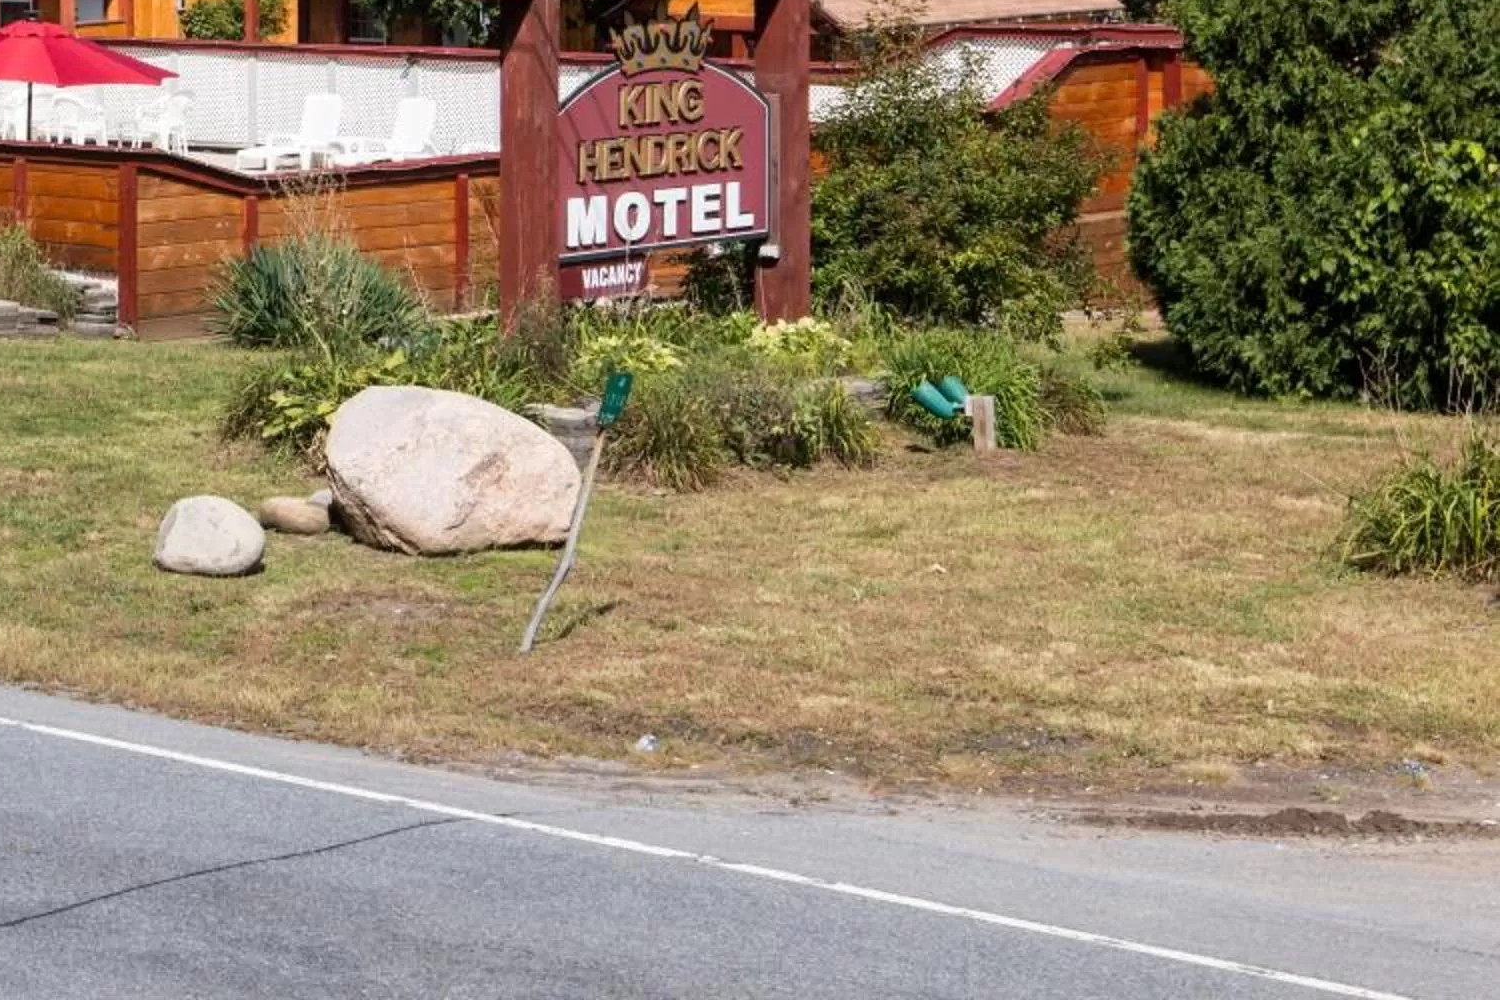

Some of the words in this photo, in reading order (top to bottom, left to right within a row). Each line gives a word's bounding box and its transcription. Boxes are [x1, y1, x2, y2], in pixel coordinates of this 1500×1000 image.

[619, 79, 705, 129] KING
[577, 126, 744, 185] HENDRICK
[565, 181, 754, 249] MOTEL
[581, 261, 643, 289] VACANCY
